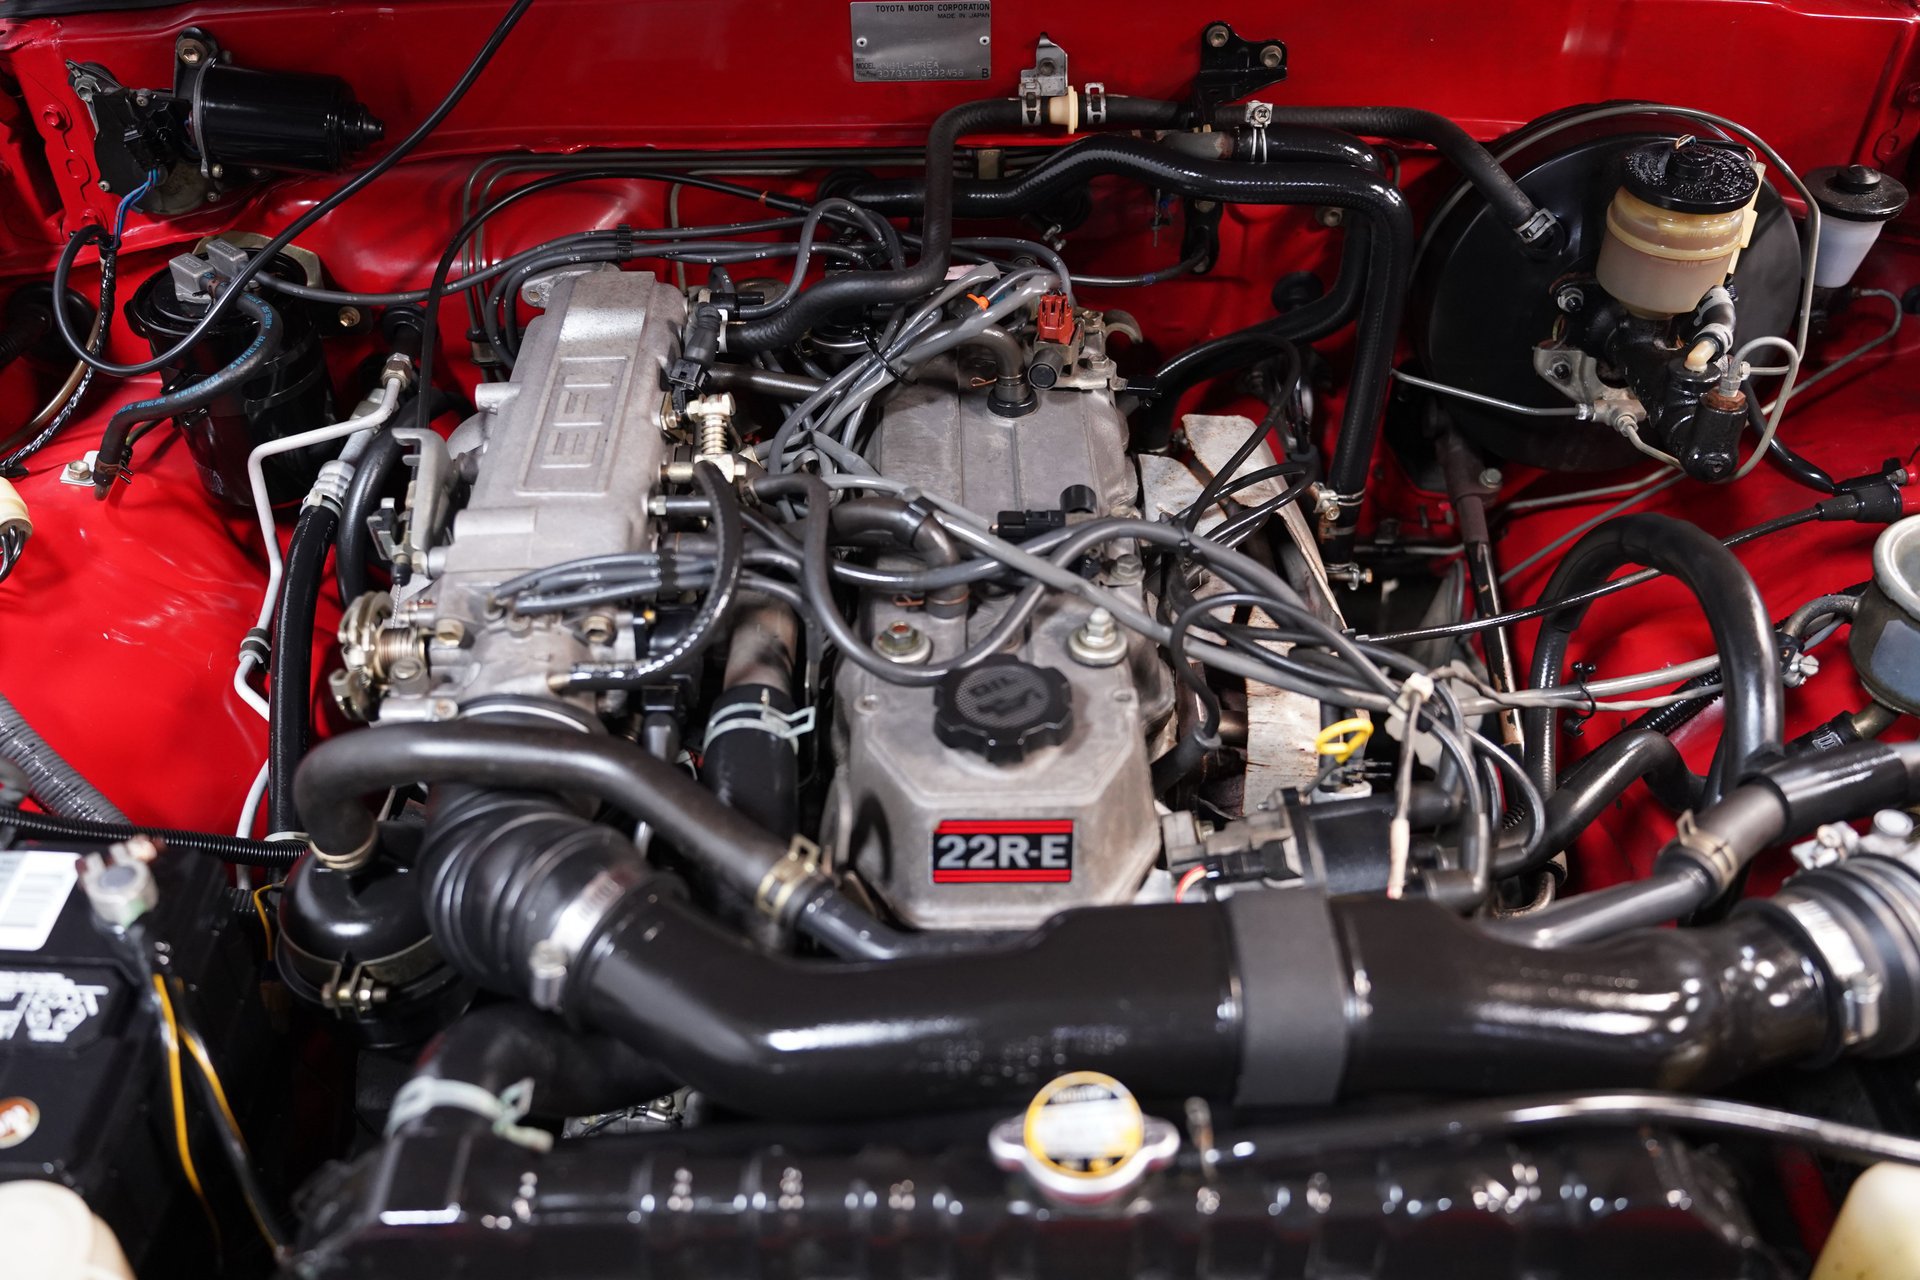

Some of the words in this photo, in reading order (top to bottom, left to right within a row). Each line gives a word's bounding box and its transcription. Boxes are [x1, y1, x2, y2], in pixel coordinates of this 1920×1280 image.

[876, 5, 905, 13] TOYOTA
[908, 4, 934, 12] MOTOR
[937, 3, 990, 11] CORPORATION
[981, 68, 989, 78] B
[540, 374, 613, 469] EFI
[969, 677, 1019, 697] OIL
[937, 834, 1069, 869] 22R-E
